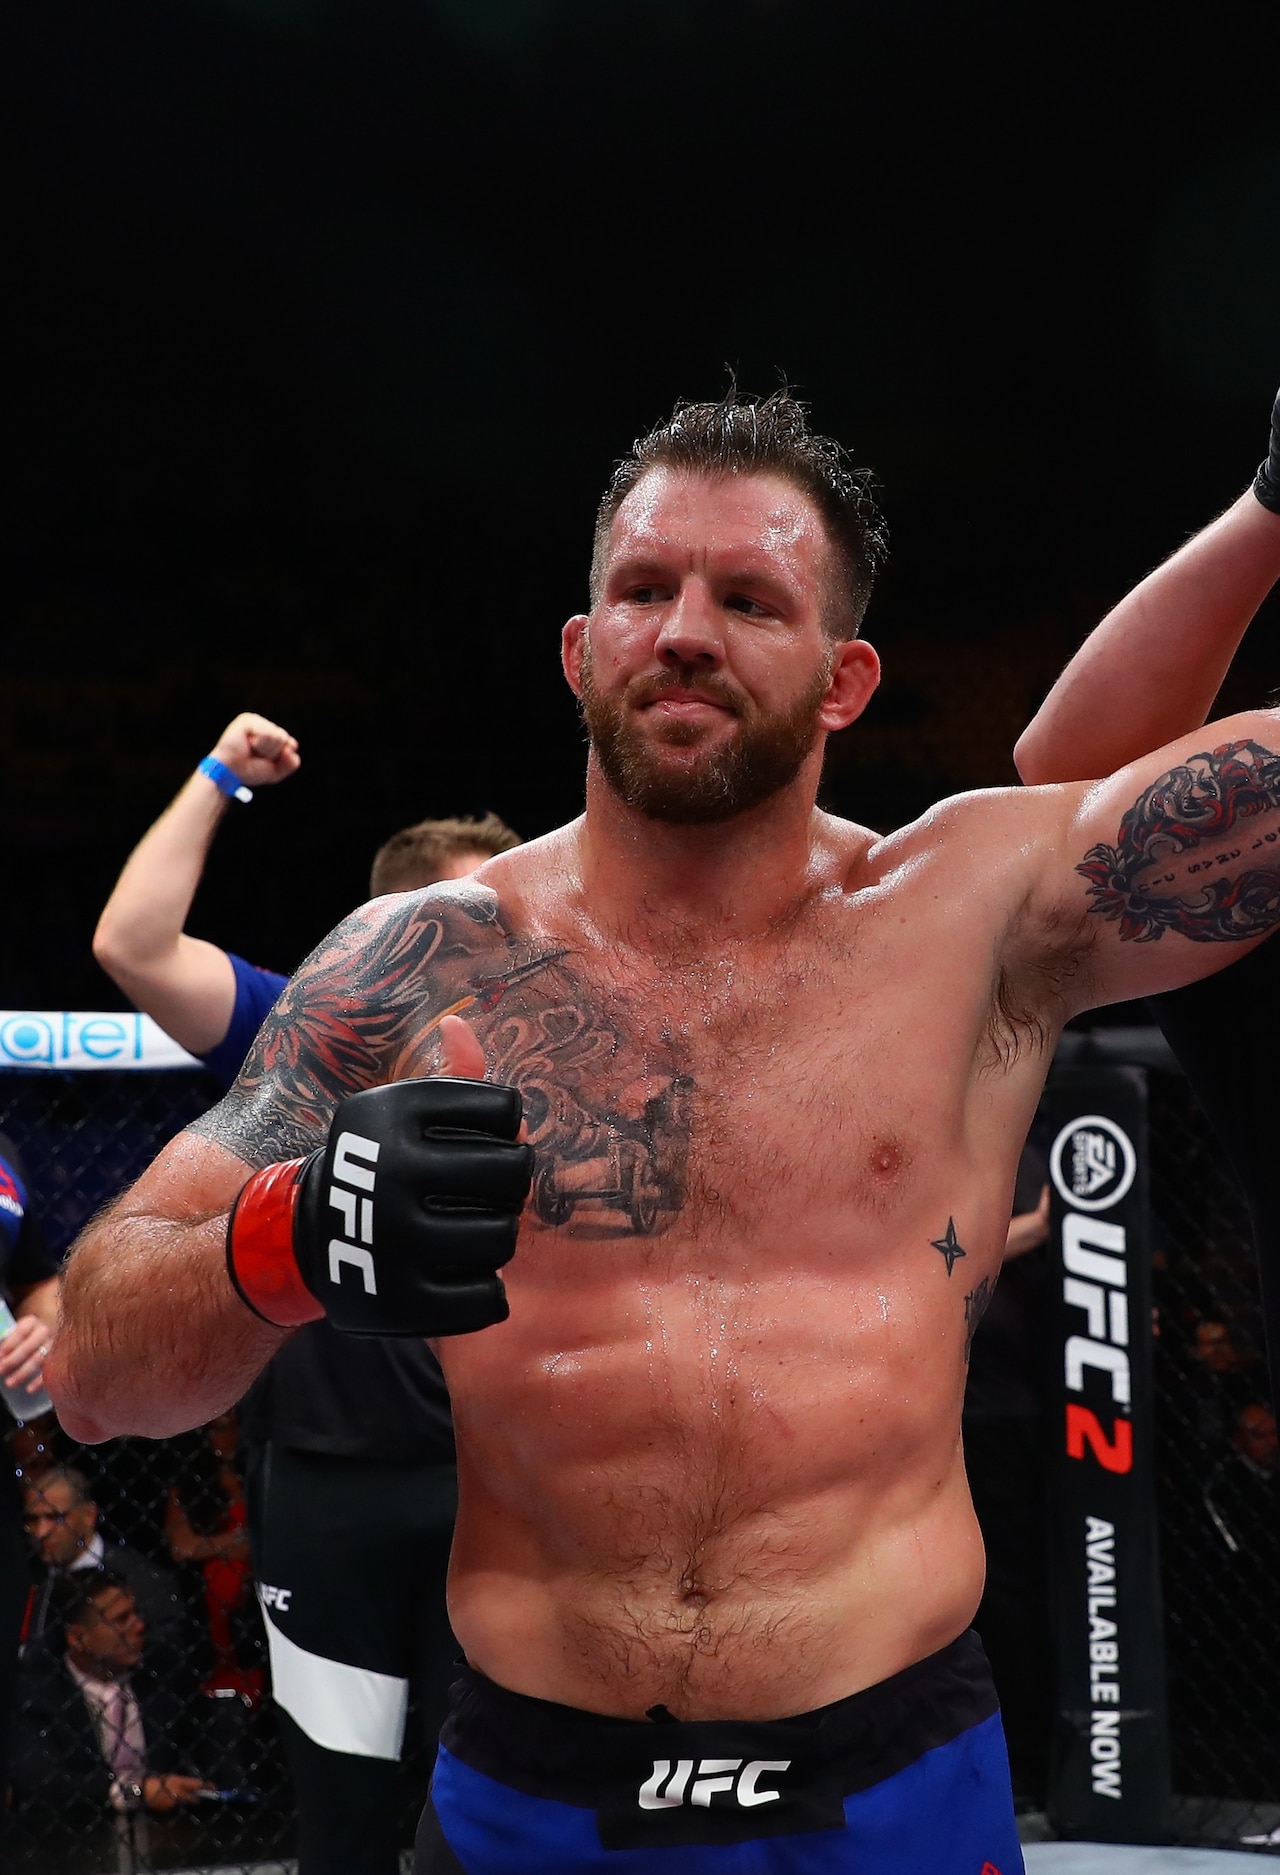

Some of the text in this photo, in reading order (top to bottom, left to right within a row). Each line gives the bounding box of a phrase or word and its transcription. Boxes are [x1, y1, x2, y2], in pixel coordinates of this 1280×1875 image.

[328, 1131, 381, 1296] UFC
[1061, 1211, 1134, 1475] UFC 2
[1085, 1515, 1123, 1800] AVAILABLE NOW
[637, 1758, 792, 1810] UFC
